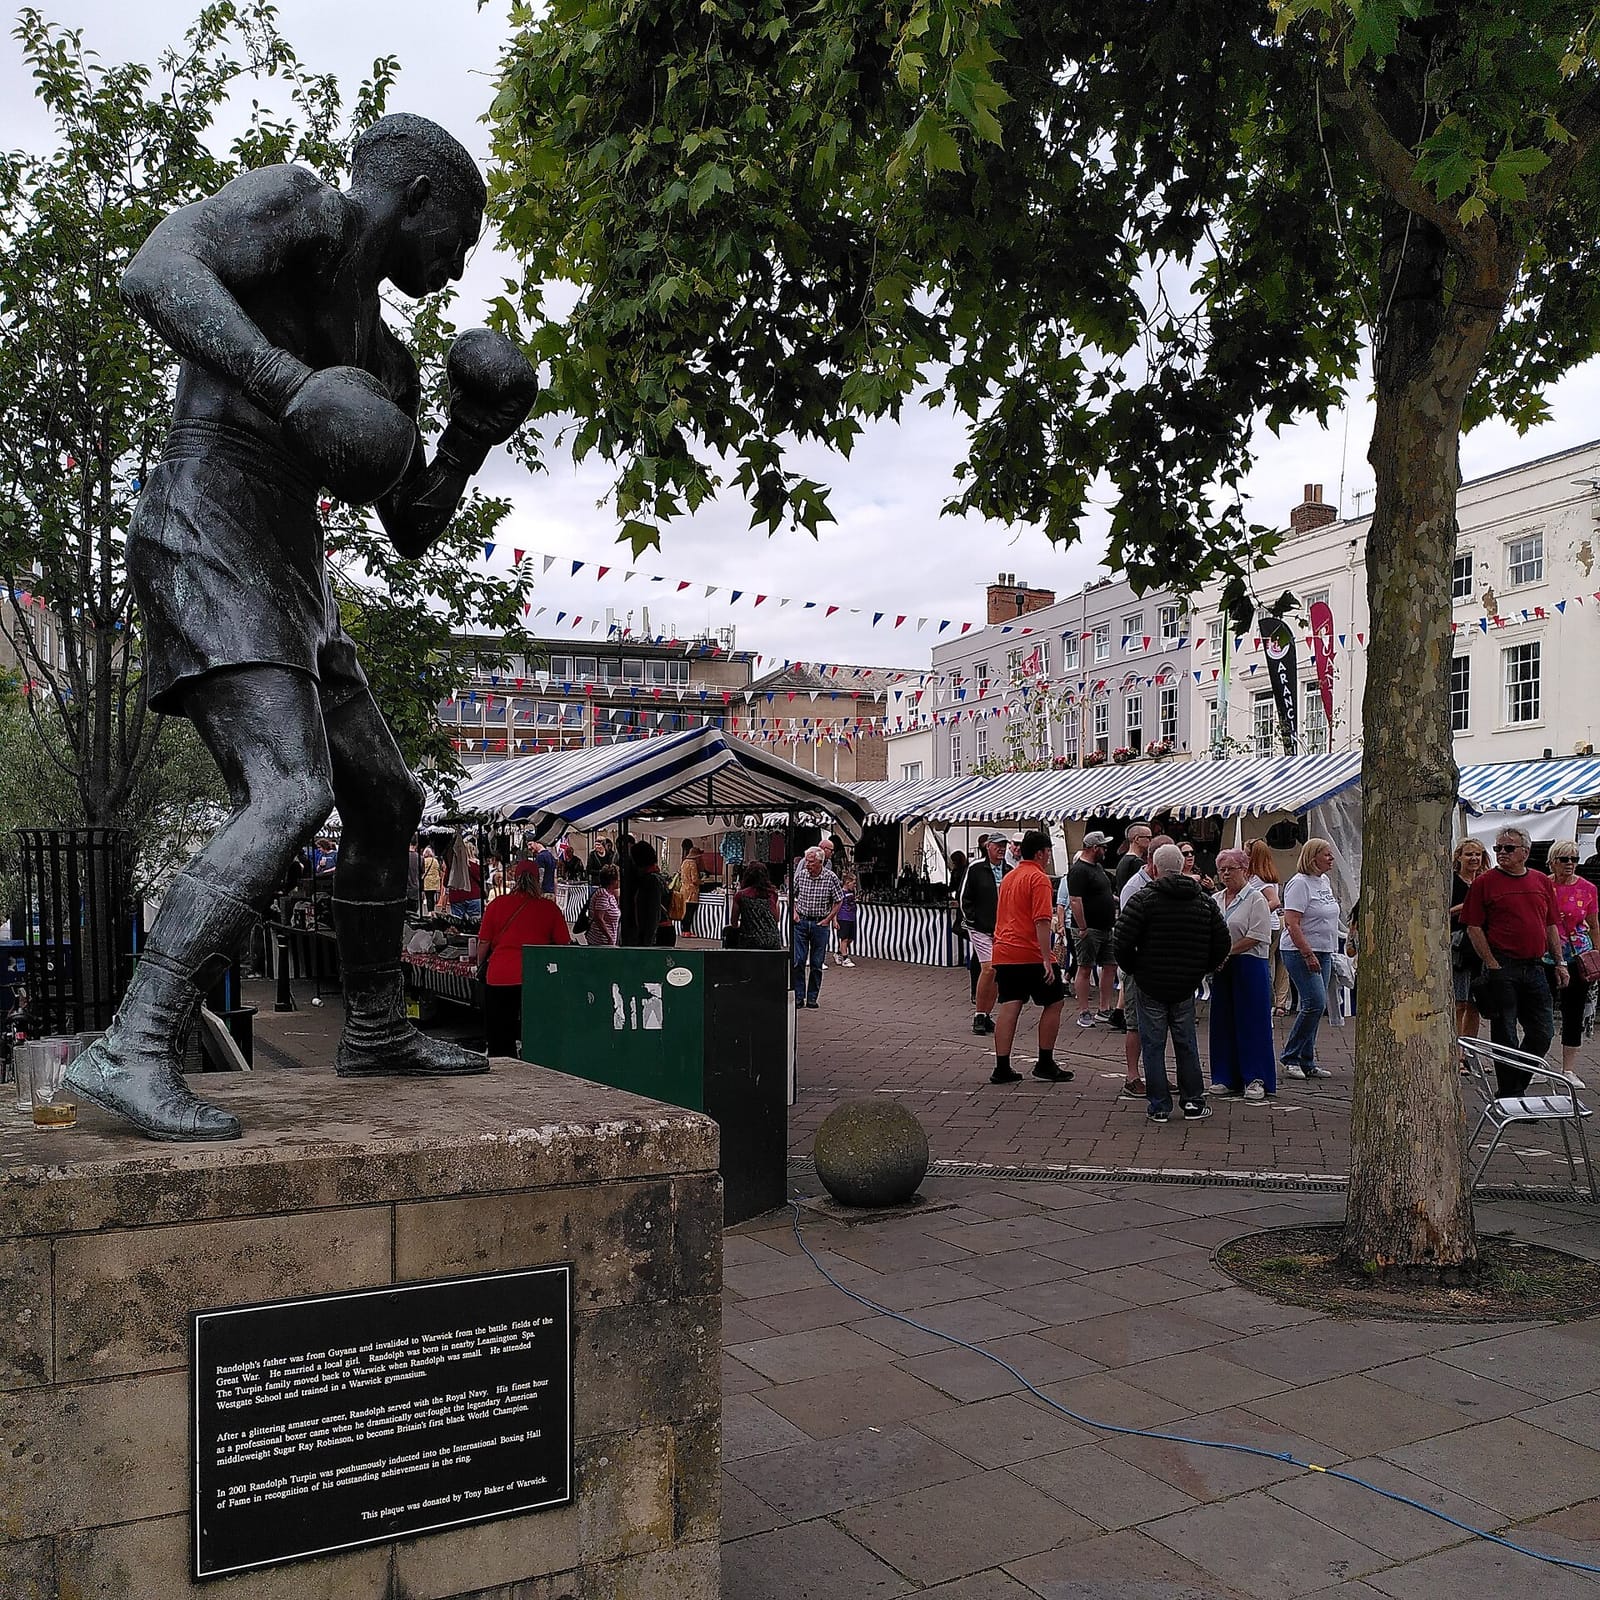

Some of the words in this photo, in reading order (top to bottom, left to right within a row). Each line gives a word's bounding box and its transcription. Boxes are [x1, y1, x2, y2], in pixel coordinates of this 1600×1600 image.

[216, 1360, 261, 1375] Randolph's
[263, 1357, 287, 1368] father
[289, 1355, 304, 1363] was
[306, 1352, 326, 1361] from
[327, 1347, 357, 1357] Guyana
[359, 1343, 373, 1353] and
[375, 1337, 409, 1350] invalided
[421, 1331, 453, 1343] Warwick
[455, 1330, 473, 1338] from
[475, 1327, 486, 1335] the
[488, 1323, 508, 1333] battle
[511, 1320, 531, 1330] fields
[532, 1318, 541, 1327] of
[542, 1317, 553, 1325] the
[216, 1376, 239, 1387] Great
[241, 1373, 260, 1382] War.
[269, 1369, 282, 1378] He
[284, 1363, 315, 1376] married
[324, 1359, 343, 1370] local
[345, 1356, 361, 1368] girl.
[369, 1350, 404, 1362] Randolph
[422, 1346, 439, 1354] born
[441, 1343, 449, 1351] in
[451, 1340, 475, 1350] nearby
[477, 1334, 518, 1346] Leamington
[522, 1330, 536, 1340] Spa.
[216, 1389, 232, 1398] The
[234, 1384, 263, 1396] Turpin
[265, 1379, 291, 1391] family
[293, 1374, 319, 1386] moved
[321, 1371, 340, 1382] back
[352, 1364, 386, 1376] Warwick
[388, 1362, 408, 1370] when
[410, 1355, 445, 1367] Randolph
[447, 1353, 460, 1361] was
[462, 1349, 482, 1359] small.
[490, 1346, 501, 1355] He
[502, 1341, 531, 1353] attended
[216, 1399, 253, 1410] Westgate
[255, 1392, 282, 1404] School
[284, 1389, 299, 1399] and
[301, 1384, 329, 1396] trained
[331, 1383, 339, 1392] in
[348, 1376, 382, 1388] Warwick
[384, 1370, 427, 1385] gymnasium.
[216, 1432, 239, 1442] After
[249, 1424, 286, 1439] glittering
[288, 1418, 320, 1430] amateur
[321, 1414, 347, 1424] career,
[349, 1405, 386, 1419] Randolph
[387, 1401, 411, 1412] served
[413, 1398, 430, 1407] with
[432, 1396, 444, 1405] the
[445, 1391, 467, 1403] Royal
[468, 1390, 489, 1399] Navy.
[496, 1385, 508, 1394] His
[511, 1382, 531, 1391] finest
[533, 1379, 549, 1388] hour
[216, 1446, 225, 1454] as
[235, 1435, 283, 1453] professional
[285, 1432, 308, 1442] boxer
[309, 1428, 330, 1437] came
[332, 1424, 353, 1433] when
[355, 1421, 364, 1430] he
[366, 1413, 412, 1427] dramatically
[453, 1404, 465, 1412] the
[467, 1398, 501, 1411] legendary
[504, 1392, 538, 1403] American
[216, 1449, 271, 1466] middleweight
[273, 1446, 296, 1456] Sugar
[298, 1442, 314, 1451] Ray
[316, 1436, 354, 1448] Robinson,
[366, 1428, 395, 1439] become
[396, 1421, 427, 1434] Britain's
[428, 1419, 444, 1428] first
[446, 1414, 465, 1425] black
[467, 1409, 490, 1420] World
[493, 1404, 529, 1416] Champion.
[217, 1489, 226, 1498] In
[228, 1484, 247, 1495] 2001
[249, 1477, 288, 1492] Randolph
[290, 1471, 317, 1484] Turpin
[319, 1470, 334, 1478] was
[336, 1459, 387, 1477] posthumously
[389, 1451, 420, 1465] inducted
[422, 1450, 437, 1459] into
[439, 1447, 451, 1456] the
[453, 1437, 497, 1453] International
[500, 1434, 525, 1444] Boxing
[526, 1429, 541, 1439] Hall
[217, 1500, 226, 1509] of
[229, 1497, 251, 1507] Fame
[253, 1494, 262, 1503] in
[265, 1486, 309, 1500] recognition
[311, 1482, 320, 1492] of
[322, 1480, 334, 1489] his
[336, 1472, 379, 1487] outstanding
[381, 1463, 430, 1478] achievements
[432, 1460, 440, 1468] in
[441, 1458, 454, 1466] the
[455, 1455, 472, 1464] ring.
[361, 1510, 378, 1520] This
[380, 1506, 405, 1518] plaque
[407, 1502, 420, 1510] was
[422, 1494, 451, 1508] donated
[452, 1494, 462, 1503] by
[464, 1490, 482, 1499] Tony
[484, 1485, 505, 1495] Baker
[506, 1481, 515, 1490] of
[516, 1476, 548, 1488] Warwick.
